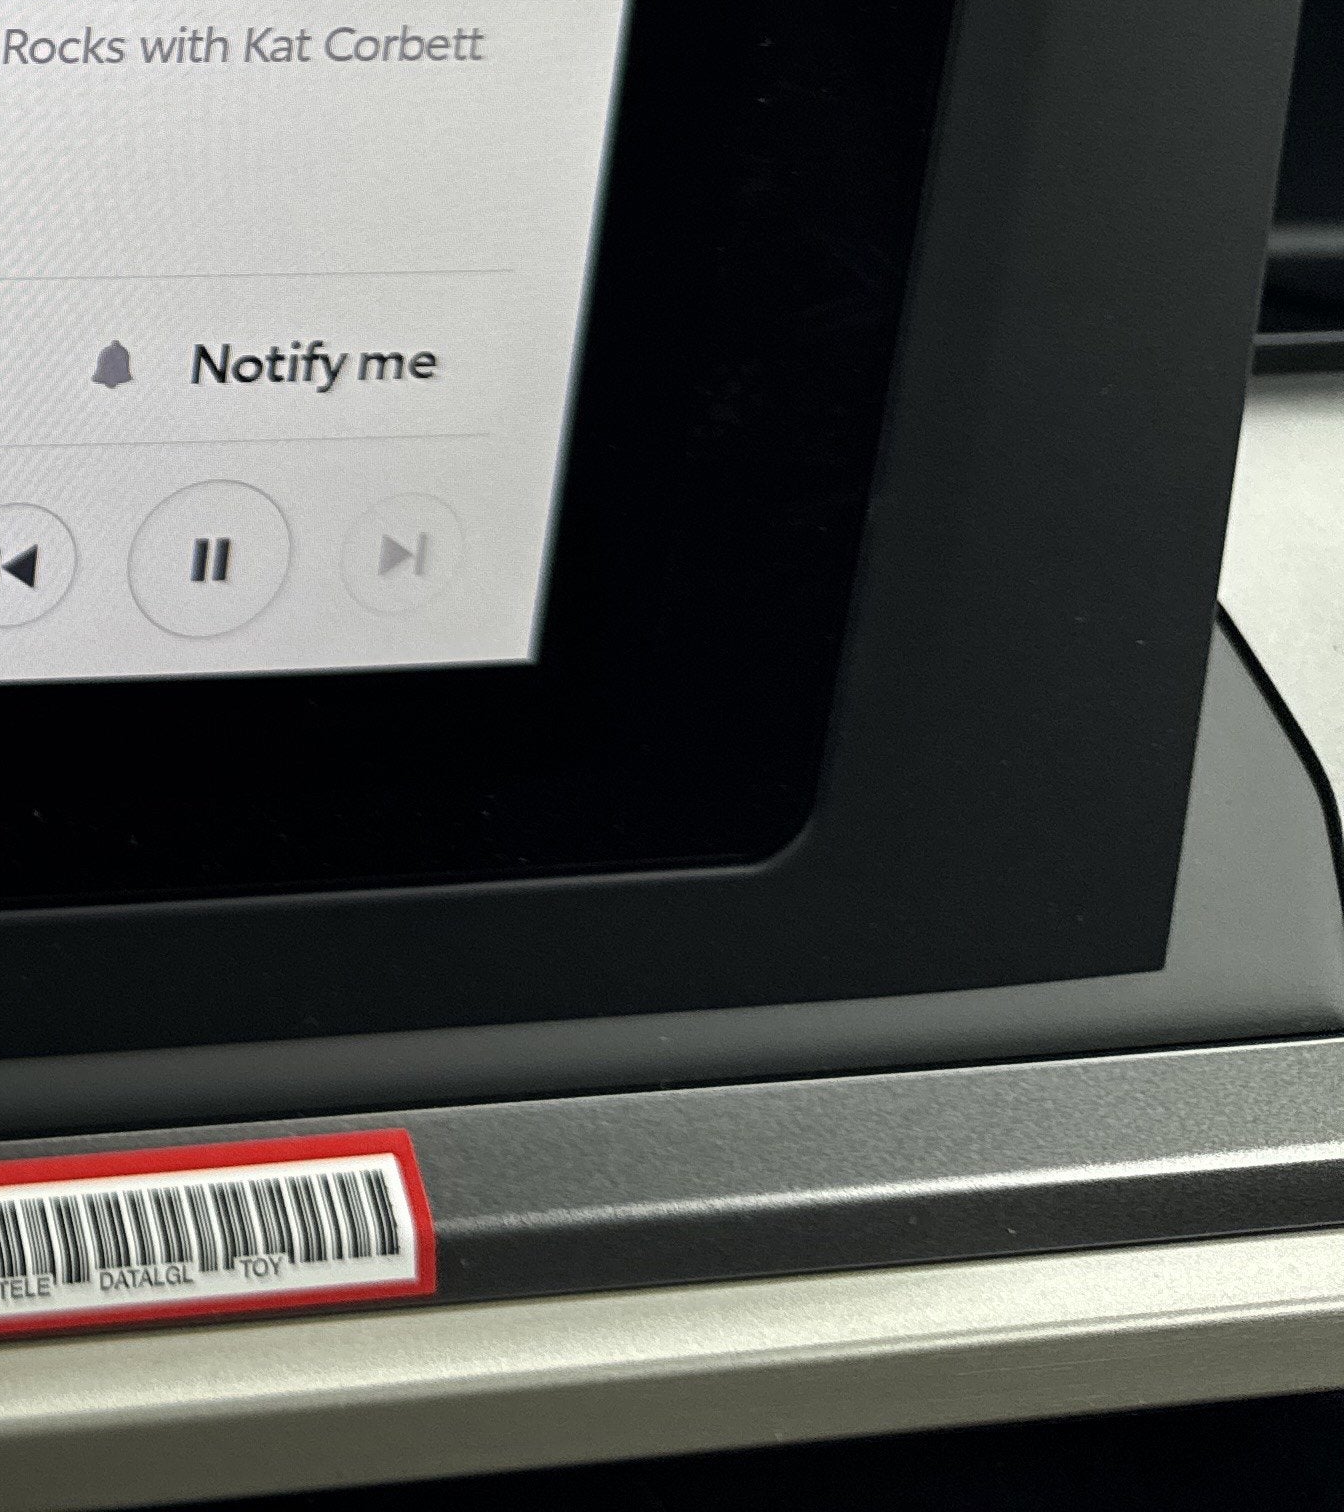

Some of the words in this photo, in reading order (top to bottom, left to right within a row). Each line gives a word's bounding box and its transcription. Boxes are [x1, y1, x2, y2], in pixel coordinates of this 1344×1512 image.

[140, 26, 229, 64] with
[244, 26, 311, 64] Kat
[322, 25, 485, 61] Corbett
[192, 341, 348, 391] Notify
[357, 346, 437, 382] me
[240, 1256, 282, 1278] TOY
